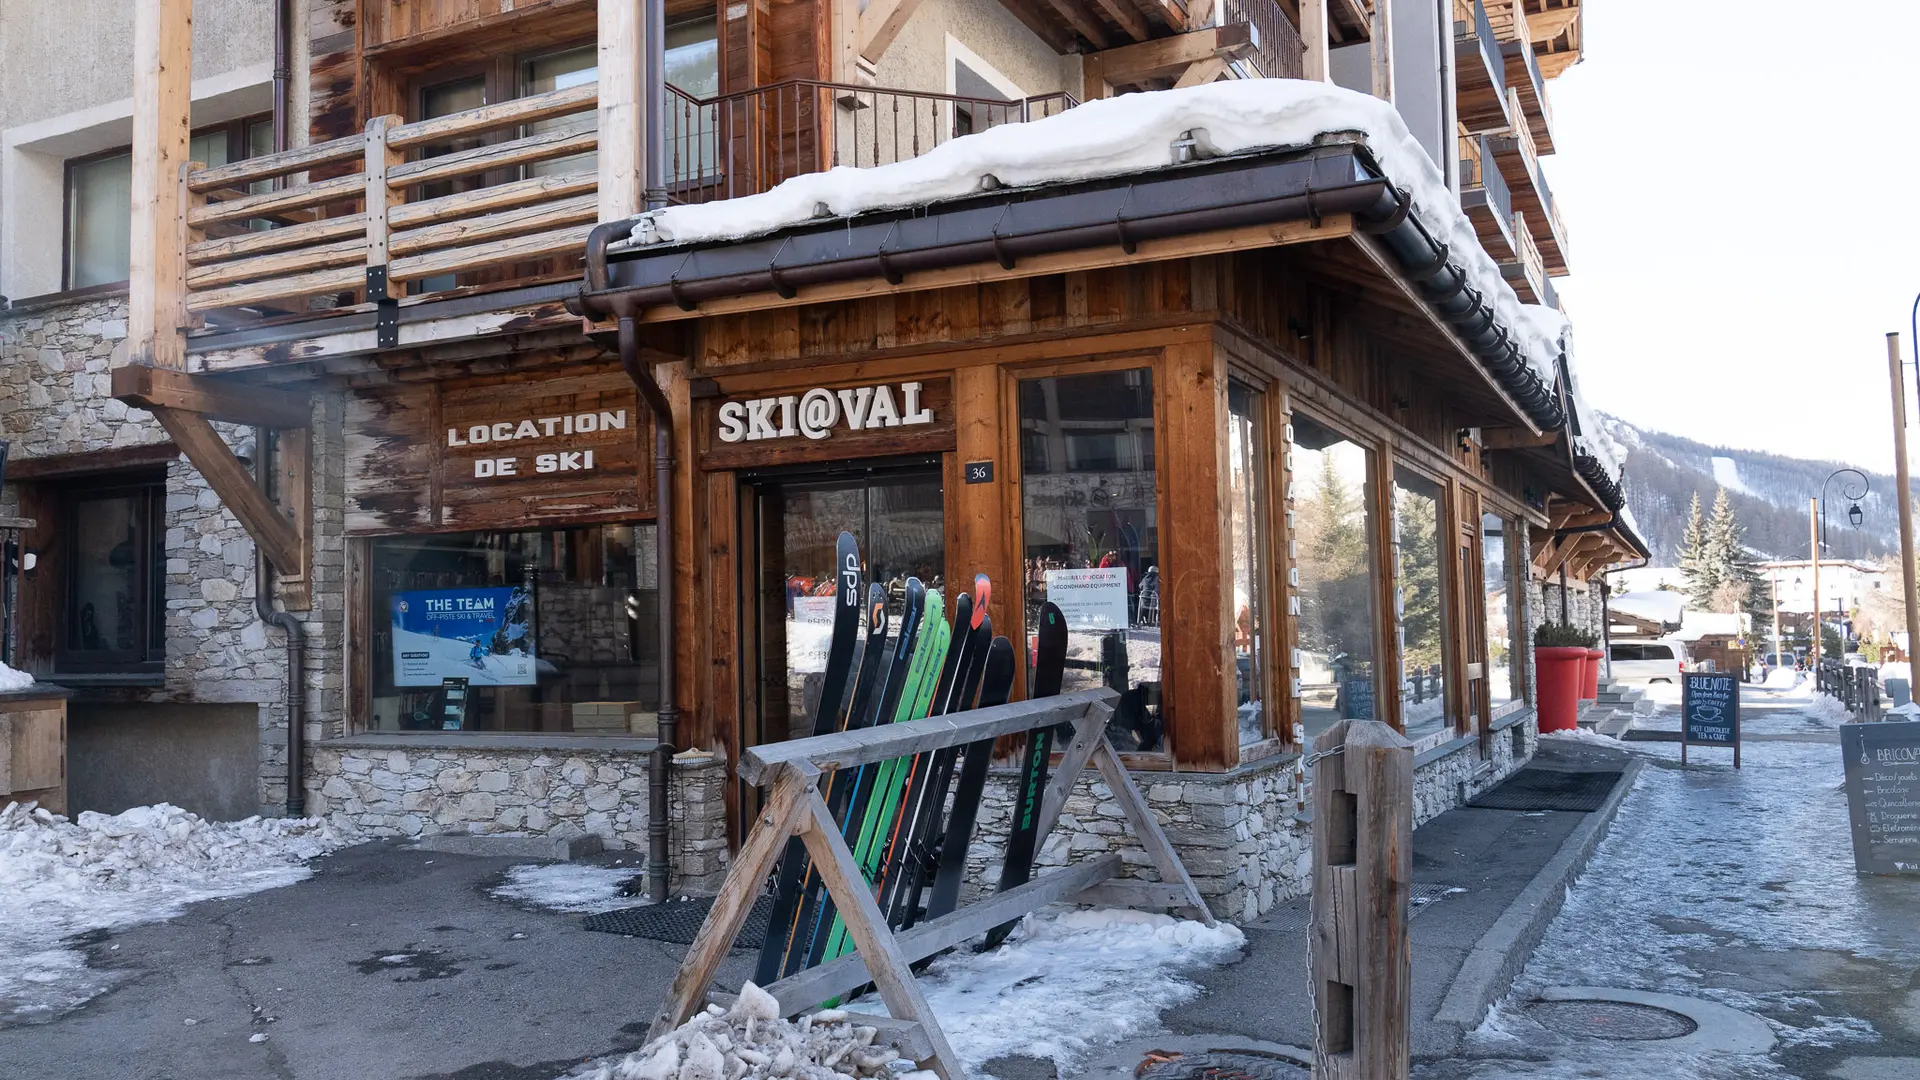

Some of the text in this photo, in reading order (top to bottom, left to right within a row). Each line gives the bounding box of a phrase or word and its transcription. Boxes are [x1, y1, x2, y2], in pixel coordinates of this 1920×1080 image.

[719, 381, 934, 443] SKI@VAL
[448, 409, 626, 447] LOCATION
[474, 450, 594, 478] DE SKI
[972, 466, 986, 479] 36
[425, 597, 494, 611] THE TEAM
[426, 612, 496, 621] OFF-PISTE SKI & TRAVEL
[1690, 677, 1732, 691] BLUE NOTE
[1690, 725, 1702, 733] HOT
[1021, 732, 1045, 830] BURTON
[1880, 811, 1918, 824] Droguerie
[1905, 862, 1919, 870] Val
